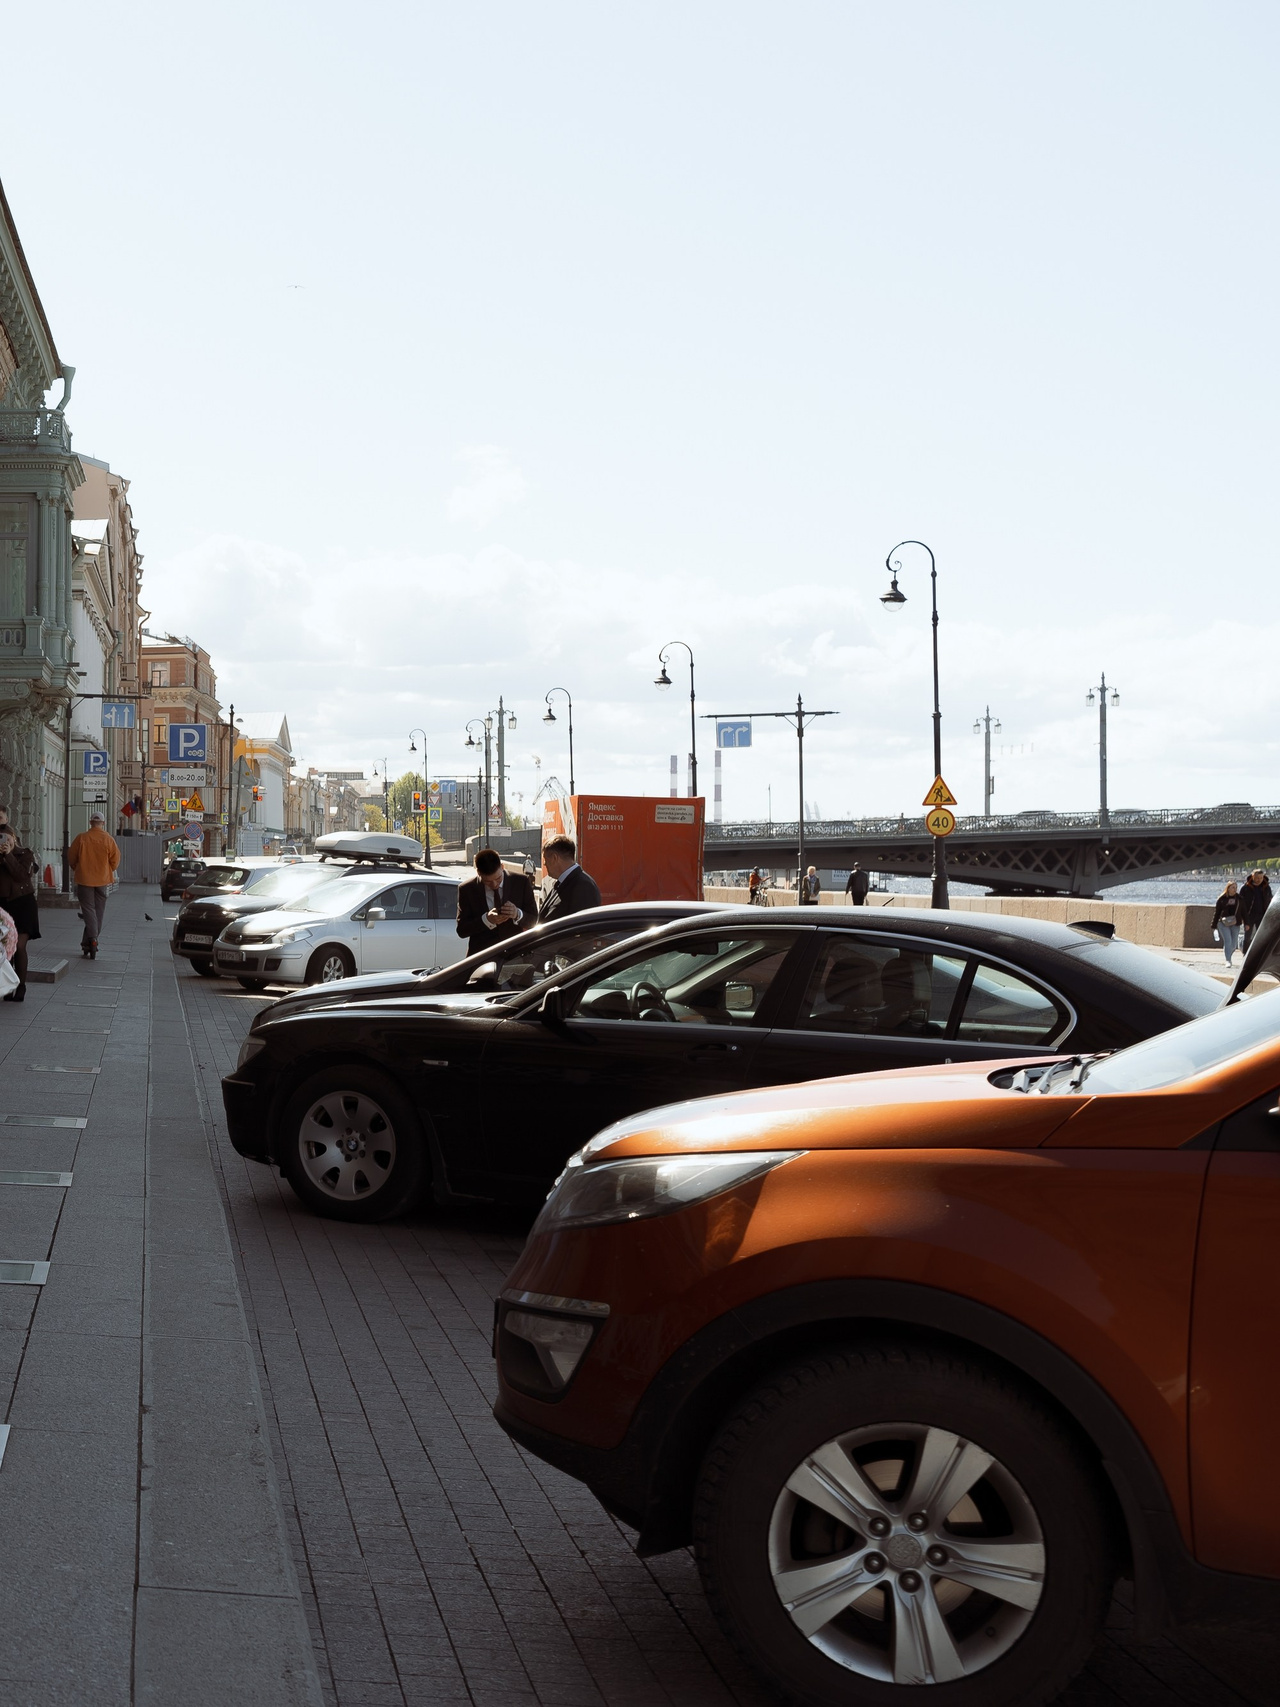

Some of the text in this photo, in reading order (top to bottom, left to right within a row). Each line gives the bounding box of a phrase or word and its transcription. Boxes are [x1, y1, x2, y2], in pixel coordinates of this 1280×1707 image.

[588, 802, 616, 811] Яндекс
[587, 812, 624, 822] Доставка
[931, 816, 949, 828] 40
